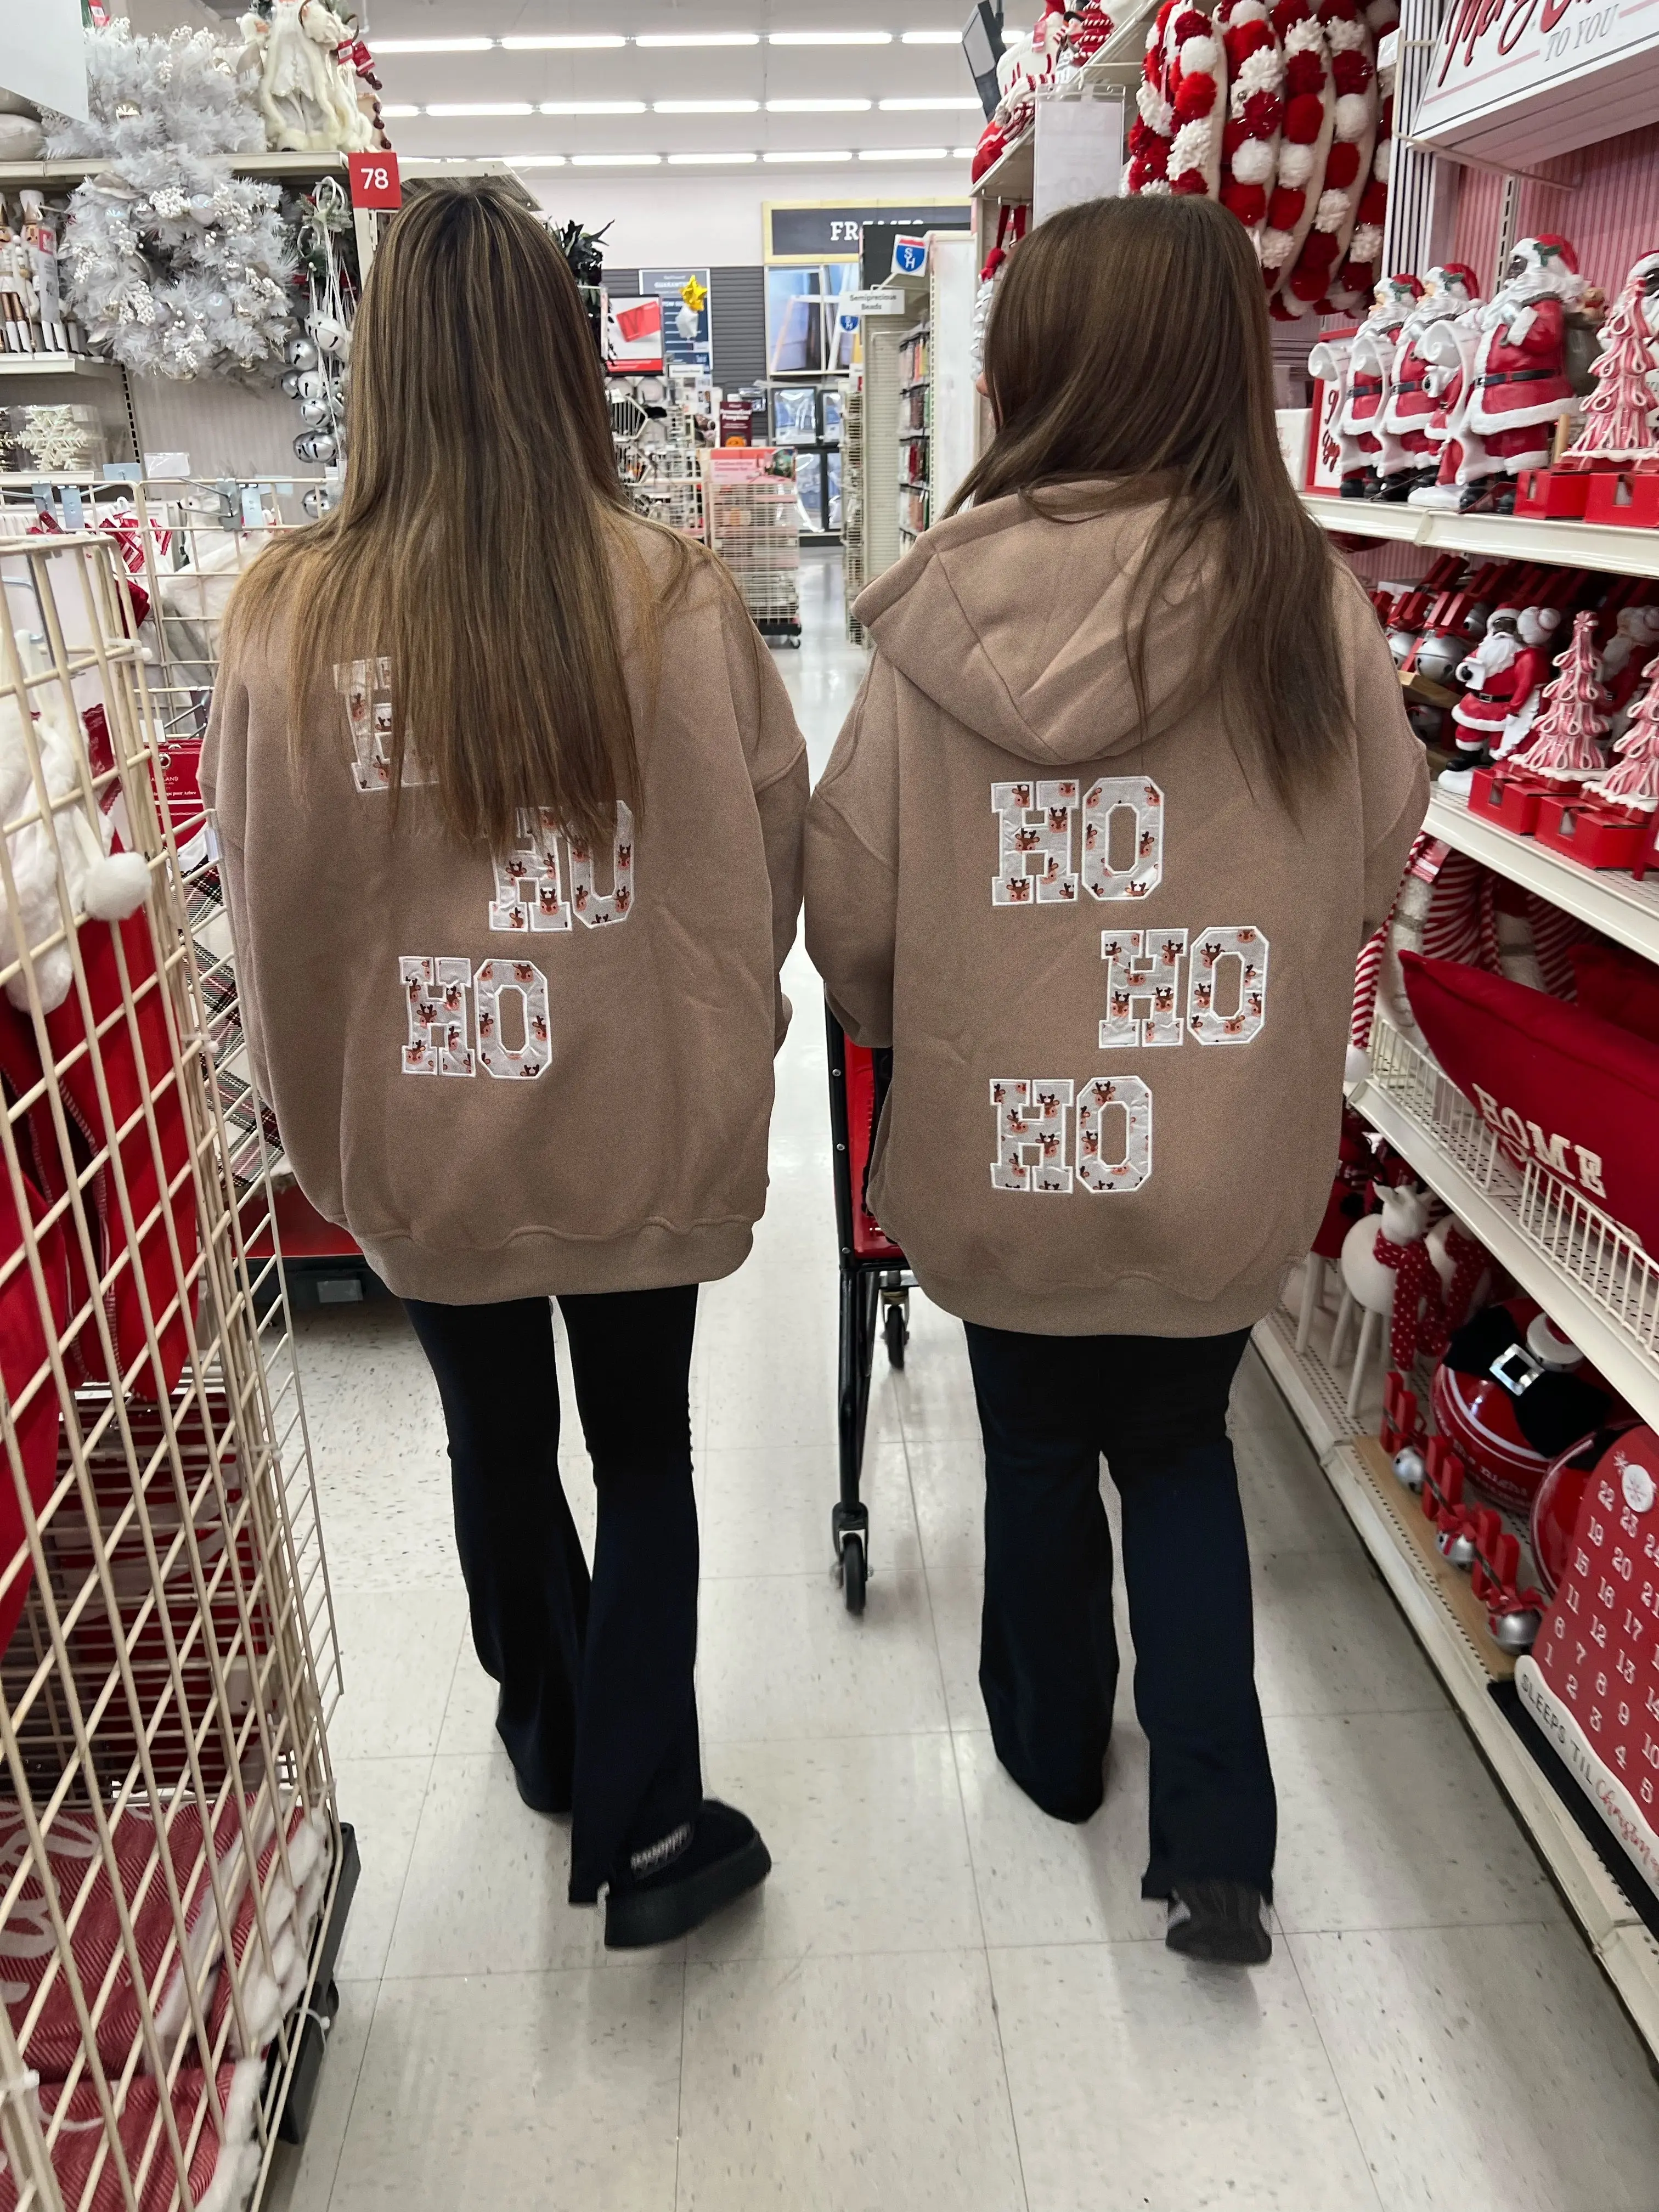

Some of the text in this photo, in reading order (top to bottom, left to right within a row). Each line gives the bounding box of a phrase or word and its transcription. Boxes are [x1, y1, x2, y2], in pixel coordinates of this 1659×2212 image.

[1544, 26, 1571, 62] TO
[1573, 3, 1620, 49] YOU
[360, 167, 389, 189] 78
[850, 293, 897, 301] Semiprecious
[991, 776, 1165, 906] HO
[398, 956, 552, 1081] HO
[1098, 926, 1269, 1049] HO
[989, 1075, 1153, 1194] HO
[1574, 1546, 1590, 1577] 15
[1623, 1607, 1644, 1642] 17
[1612, 1545, 1633, 1581] 20
[1565, 1582, 1580, 1616] 11
[1590, 1613, 1607, 1649] 12
[1616, 1649, 1636, 1684] 13
[1520, 1673, 1567, 1745] SLEEPS
[1544, 1641, 1654, 1804] 1 2 3 4 5
[1575, 1641, 1587, 1666] 7
[1595, 1671, 1608, 1697] 8
[1641, 1731, 1659, 1770] 10
